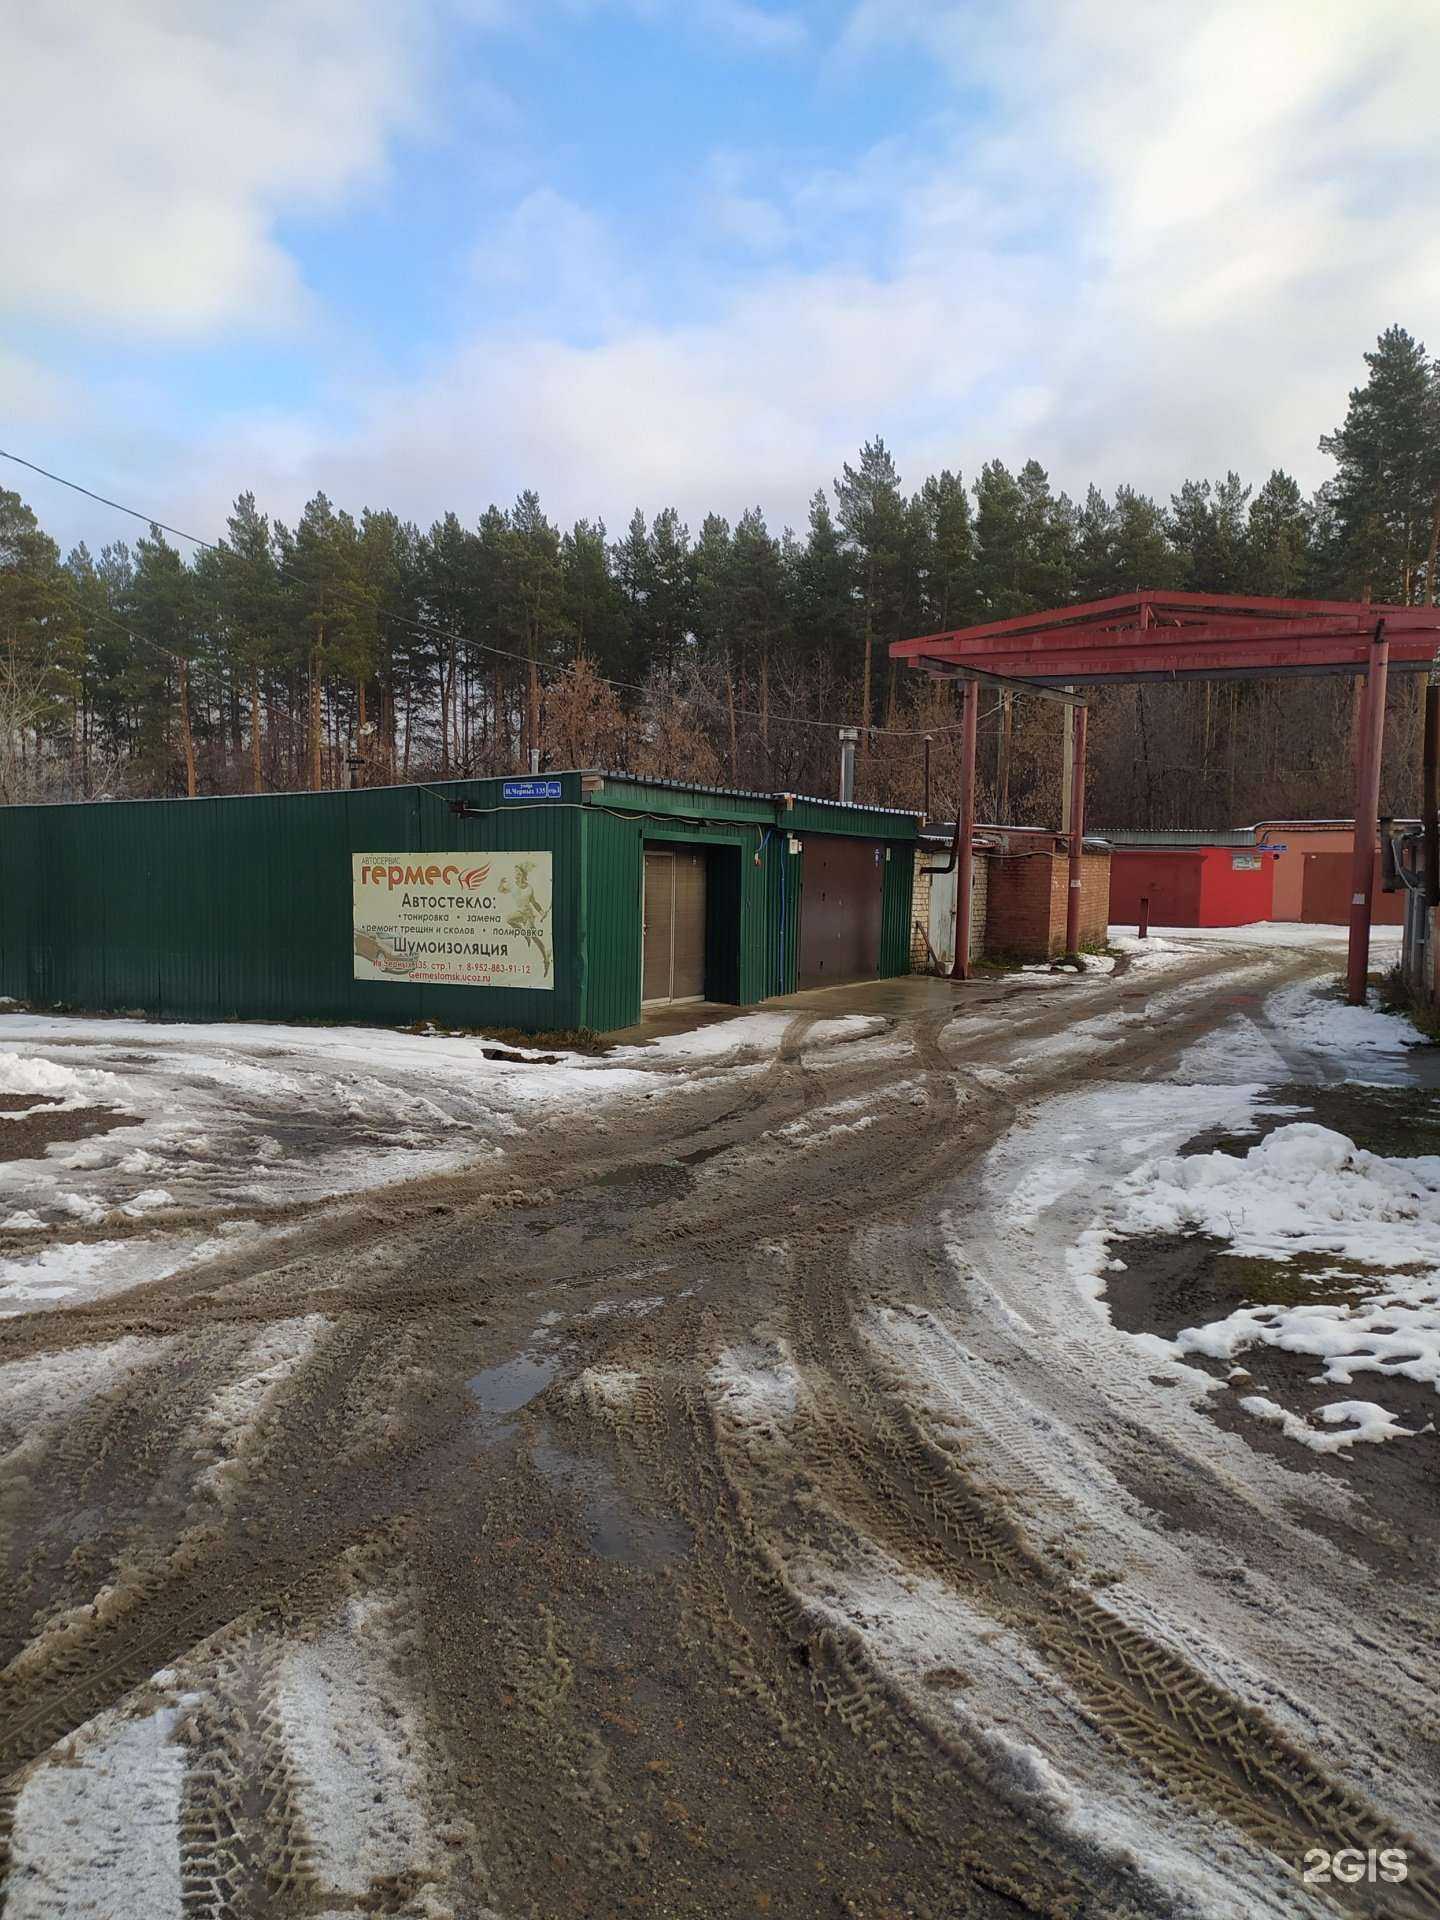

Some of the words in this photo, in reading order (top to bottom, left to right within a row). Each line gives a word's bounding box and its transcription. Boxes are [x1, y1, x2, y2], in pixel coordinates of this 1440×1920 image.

[361, 857, 401, 865] АВТОСЕРВИС
[402, 893, 497, 909] Автостекло:
[404, 914, 450, 923] тонировка
[467, 915, 501, 923] замена
[366, 925, 398, 934] ремонт
[400, 925, 434, 935] трещин
[443, 927, 475, 935] сколов
[492, 928, 544, 938] полировка
[394, 937, 508, 957] Шумоизоляция
[466, 963, 531, 974] 8-952-883-91-12
[408, 970, 491, 982] Germestomsk.ucoz.ru
